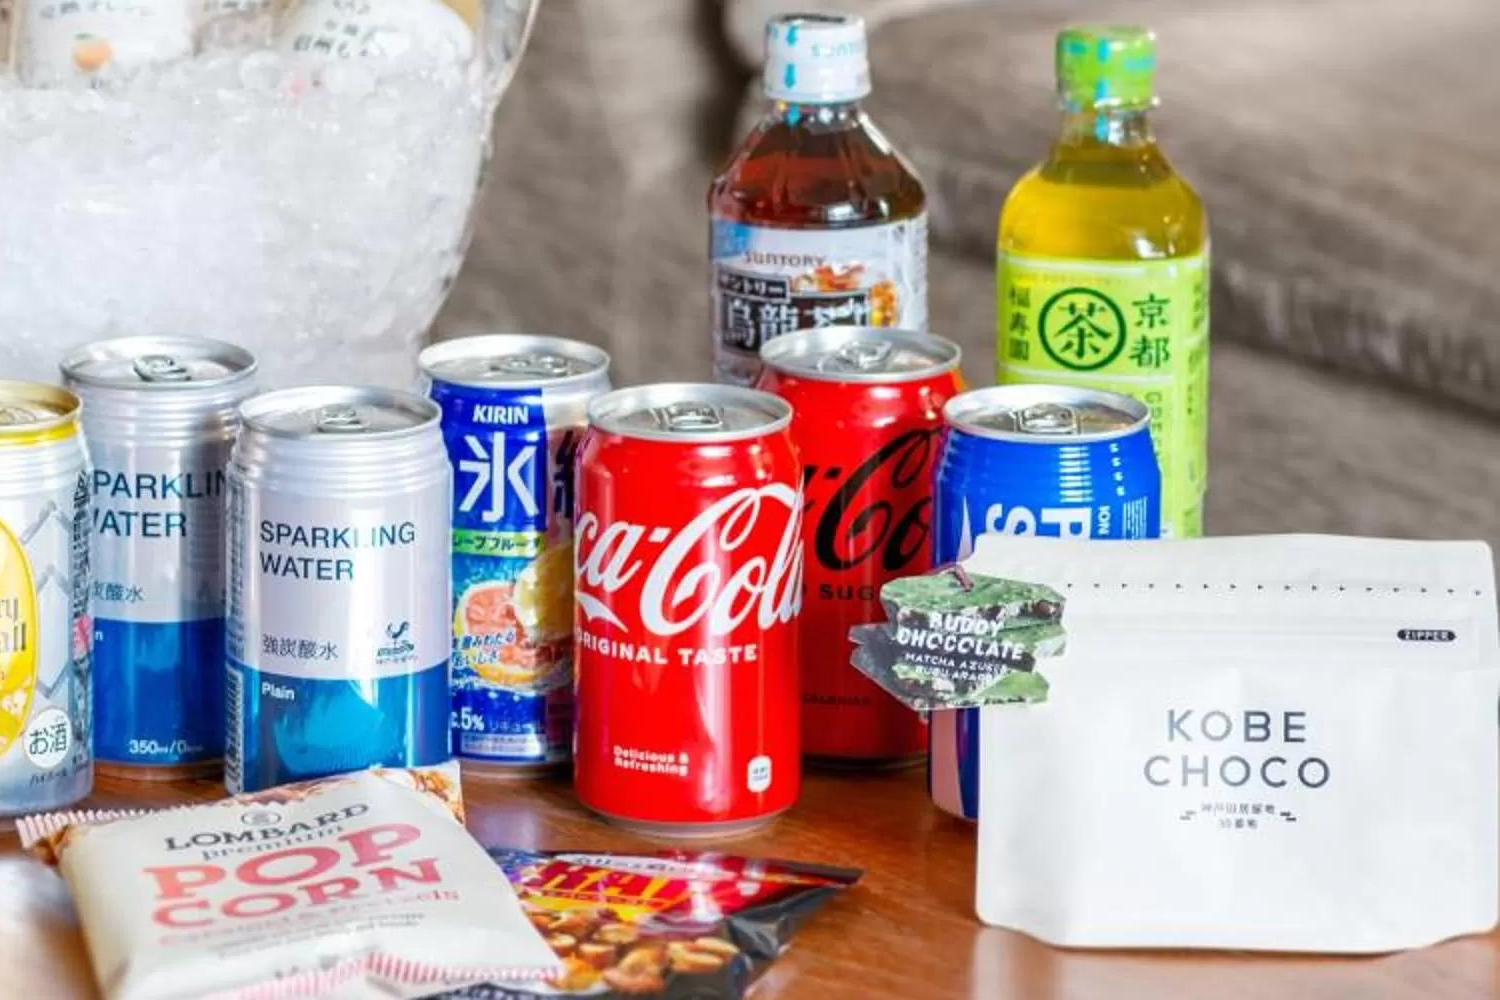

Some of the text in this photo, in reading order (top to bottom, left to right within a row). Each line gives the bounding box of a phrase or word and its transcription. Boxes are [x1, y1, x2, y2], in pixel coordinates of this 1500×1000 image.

[1054, 301, 1112, 360] 茶
[1129, 293, 1171, 369] 京都
[472, 404, 529, 425] KIRIN
[93, 469, 228, 500] PARKLIN
[260, 520, 416, 549] SPARKLING
[260, 552, 355, 581] WATER
[819, 583, 876, 601] SUG
[262, 633, 339, 661] 強炭酸水
[678, 644, 758, 665] TASTE
[905, 652, 956, 668] MATCHA
[261, 682, 295, 700] Plain
[1167, 708, 1307, 743] KOBE
[613, 745, 675, 764] Delicious
[614, 757, 690, 778] Refreshing
[1143, 754, 1332, 789] CHOCO
[165, 803, 370, 851] LOMBARD
[143, 823, 422, 899] POP
[152, 857, 442, 928] CORN
